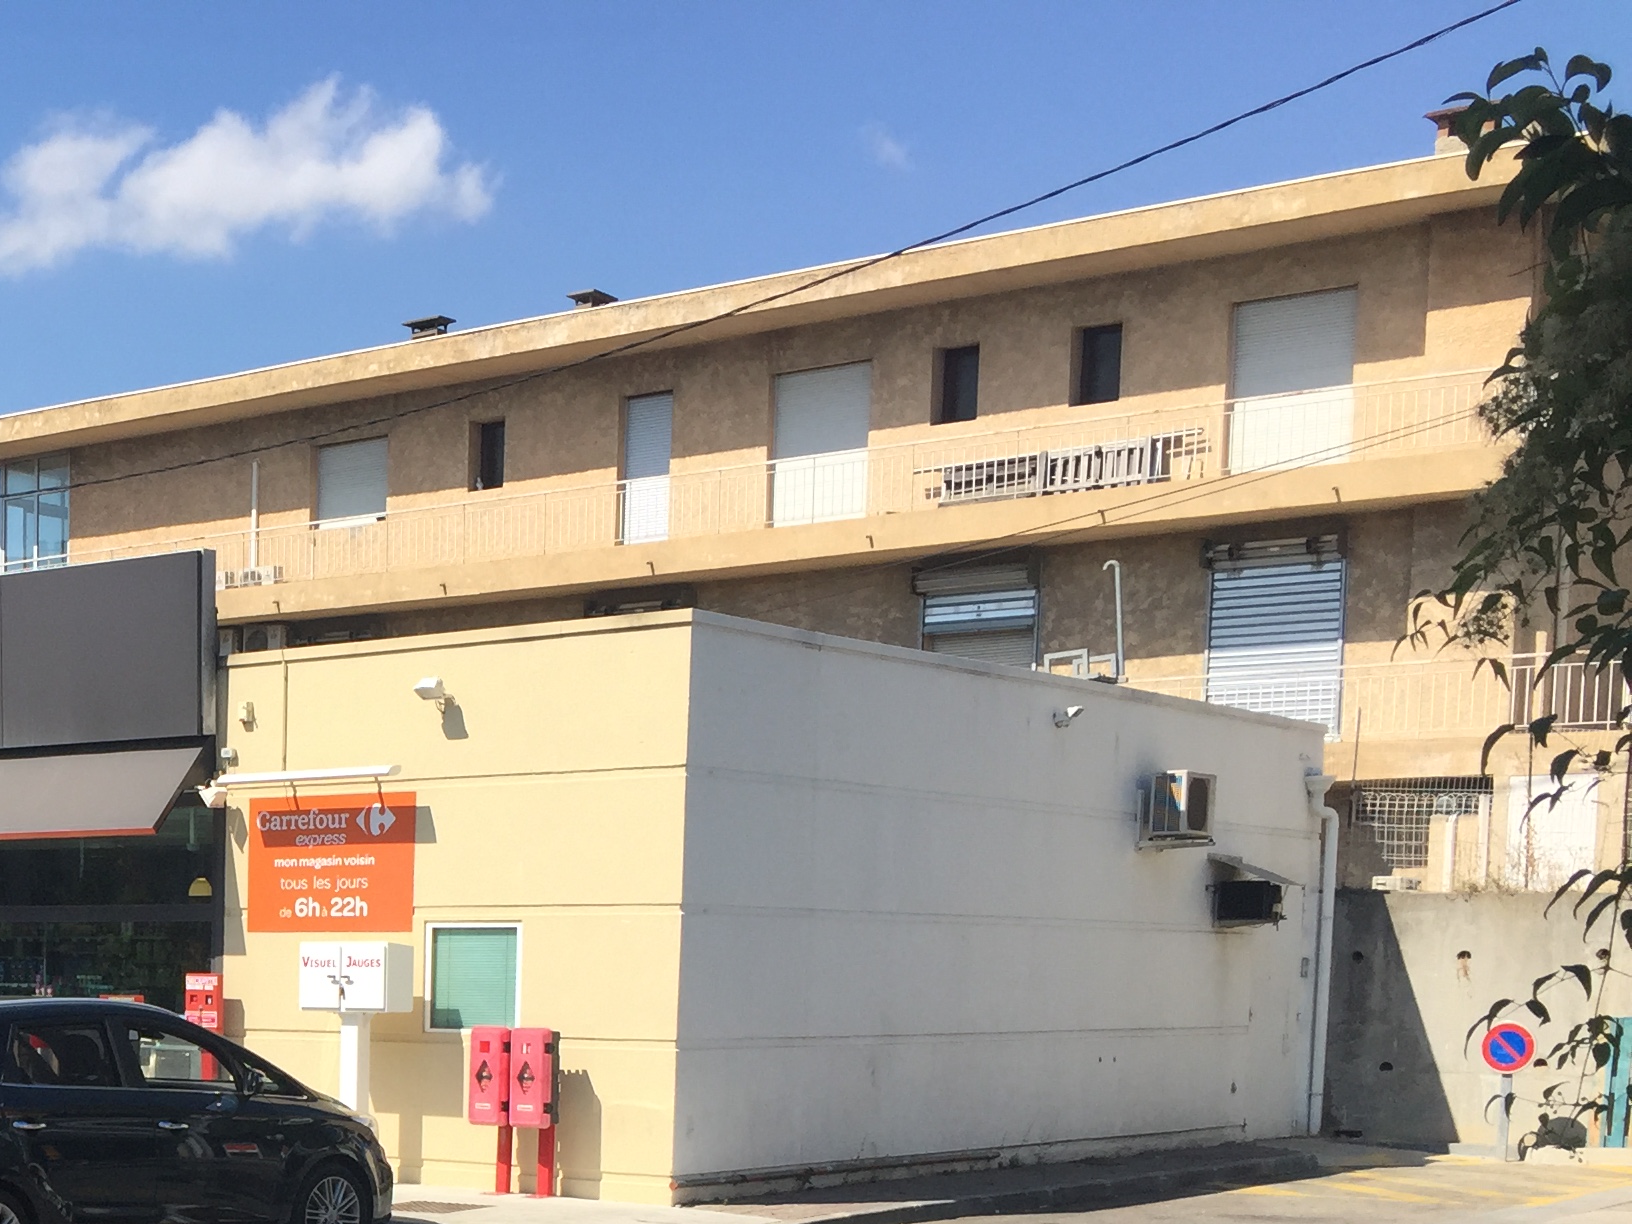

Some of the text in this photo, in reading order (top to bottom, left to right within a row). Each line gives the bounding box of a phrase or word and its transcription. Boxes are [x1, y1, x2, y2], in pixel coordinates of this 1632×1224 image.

[256, 807, 350, 832] Carrefour
[295, 833, 347, 849] express
[274, 853, 376, 869] mon magasin voisin
[280, 875, 368, 893] tous les jours
[279, 896, 368, 918] de 6h à 22h
[302, 956, 337, 968] VISUEL
[346, 956, 381, 968] JAUGES
